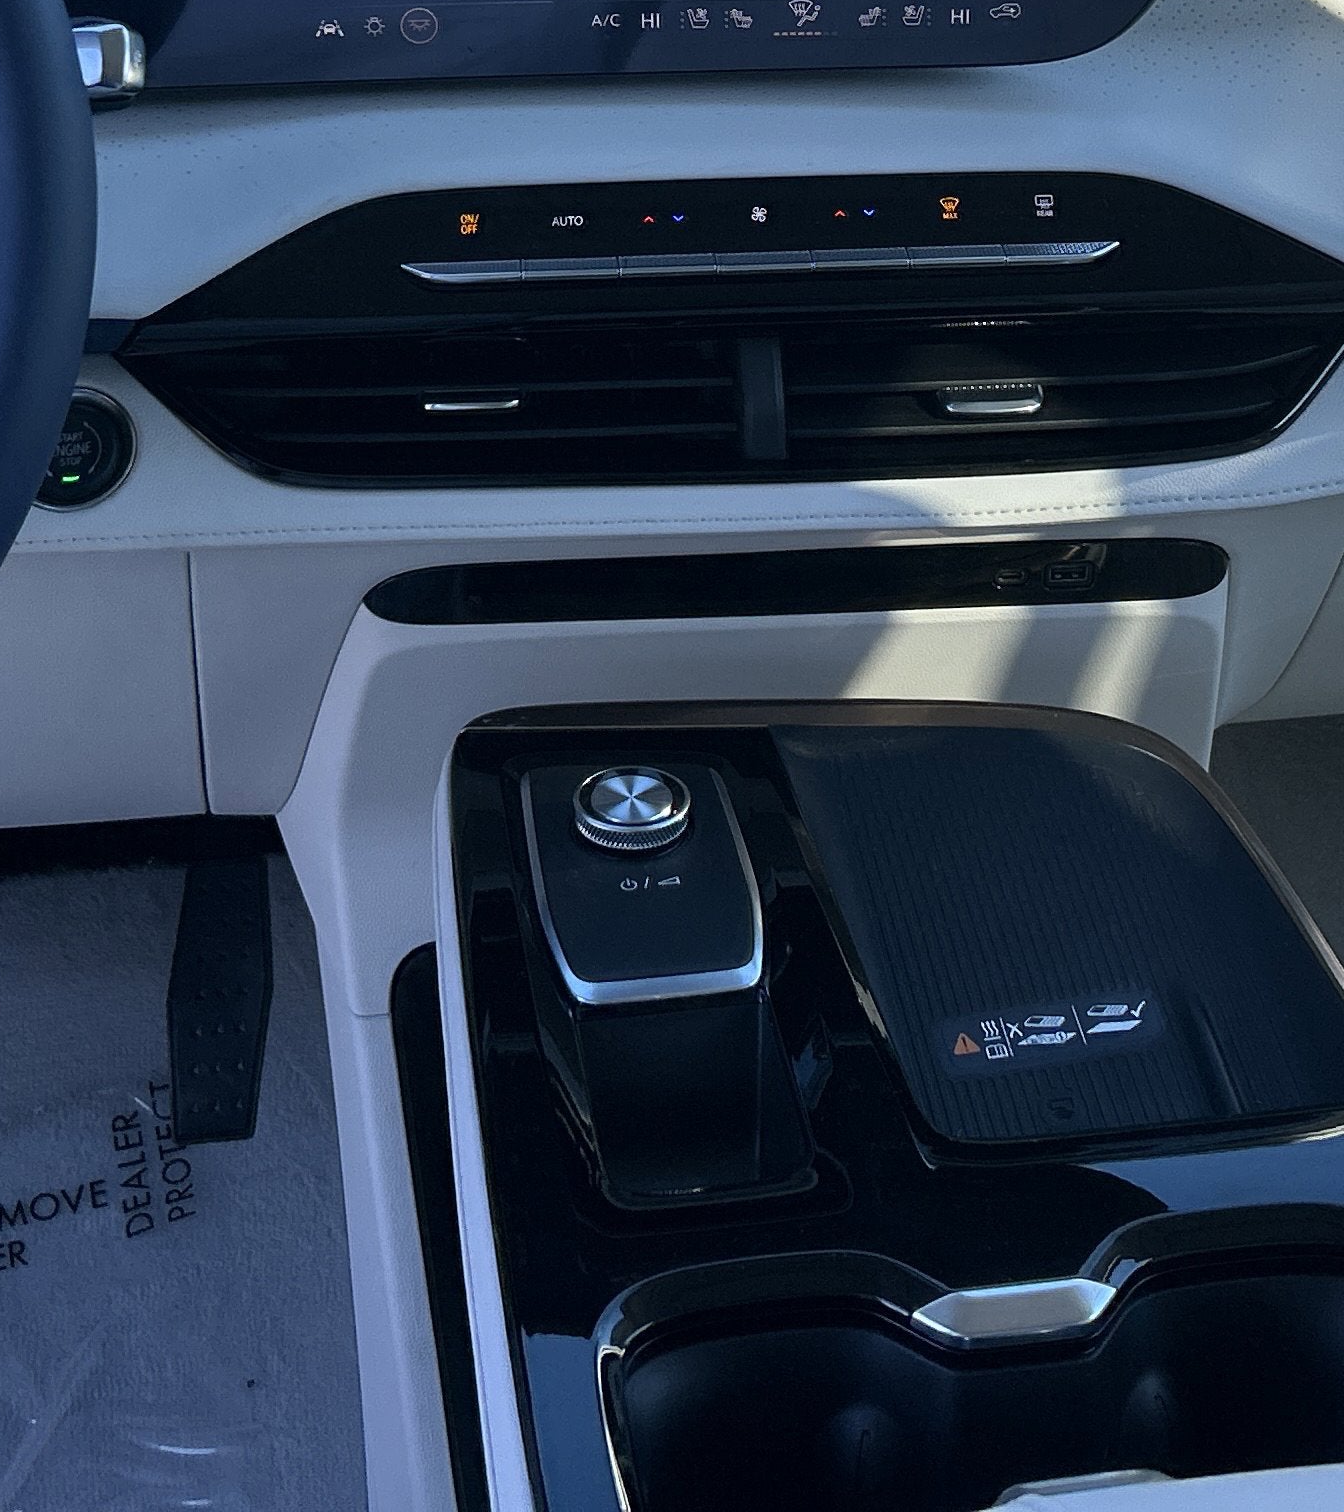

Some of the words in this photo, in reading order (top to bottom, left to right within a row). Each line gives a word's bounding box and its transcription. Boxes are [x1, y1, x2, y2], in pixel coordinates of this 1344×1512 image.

[591, 13, 621, 28] A/C
[641, 13, 661, 29] HI
[950, 9, 971, 25] HI
[460, 223, 478, 235] OFF
[551, 215, 584, 227] AUTO
[111, 1109, 155, 1239] DEALER
